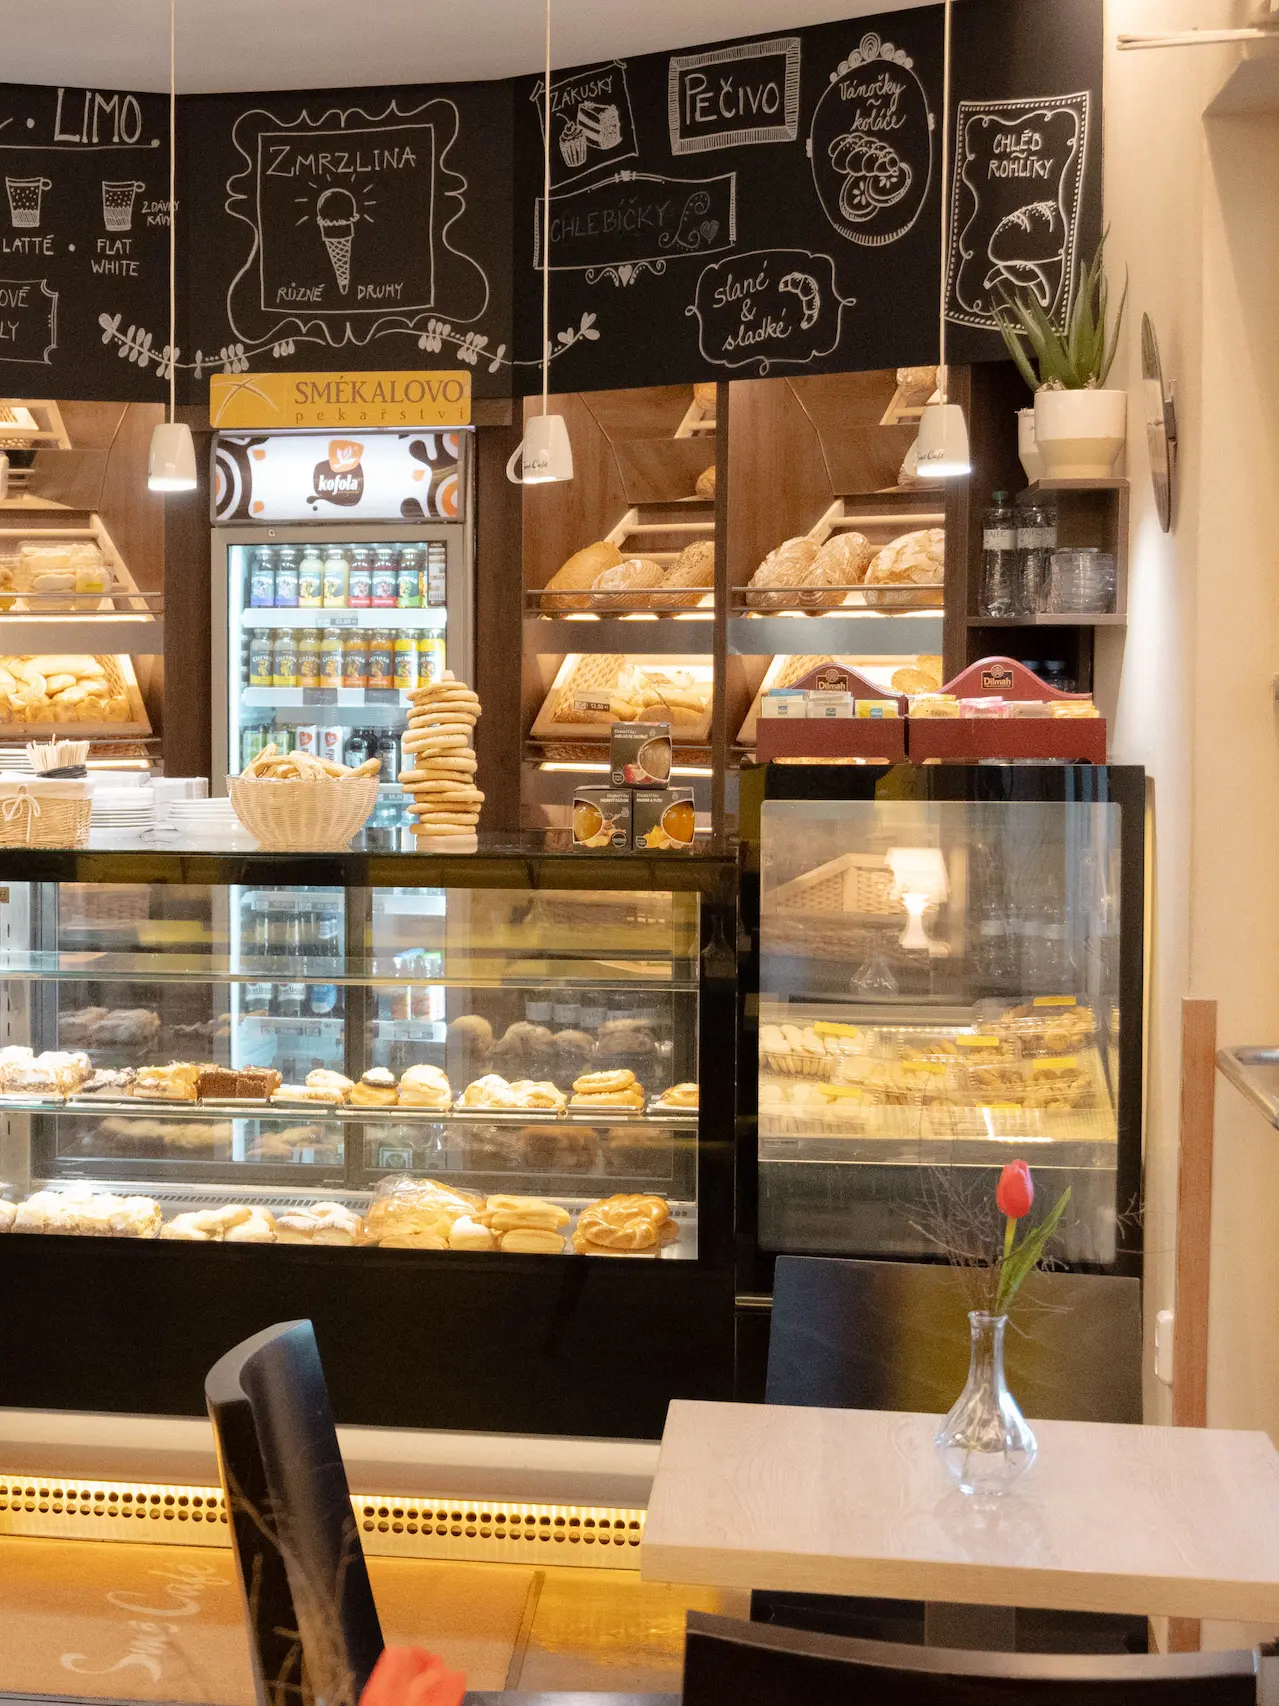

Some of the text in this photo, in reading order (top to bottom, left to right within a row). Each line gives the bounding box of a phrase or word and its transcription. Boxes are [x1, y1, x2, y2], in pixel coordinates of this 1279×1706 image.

[549, 75, 613, 112] ZÁKUSKY
[684, 73, 780, 125] PEČIVO
[54, 88, 142, 144] LIMO
[992, 129, 1042, 154] CHLÉB
[266, 146, 417, 177] ZMRZLINA
[988, 156, 1053, 180] ROHLÍKY
[151, 199, 180, 213] DÁVY
[550, 196, 671, 243] CHLEBÍČKY
[2, 234, 54, 256] LATTÉ
[97, 238, 133, 254] FLAT
[90, 260, 140, 277] WHITE
[276, 282, 404, 303] RŮZNÉ DRUHY
[712, 260, 770, 308] slané
[722, 307, 794, 352] sladké
[293, 375, 465, 406] SMÉKALOVO
[317, 473, 359, 496] kofola
[818, 681, 847, 690] Dilmah
[984, 676, 1012, 686] Dilmah
